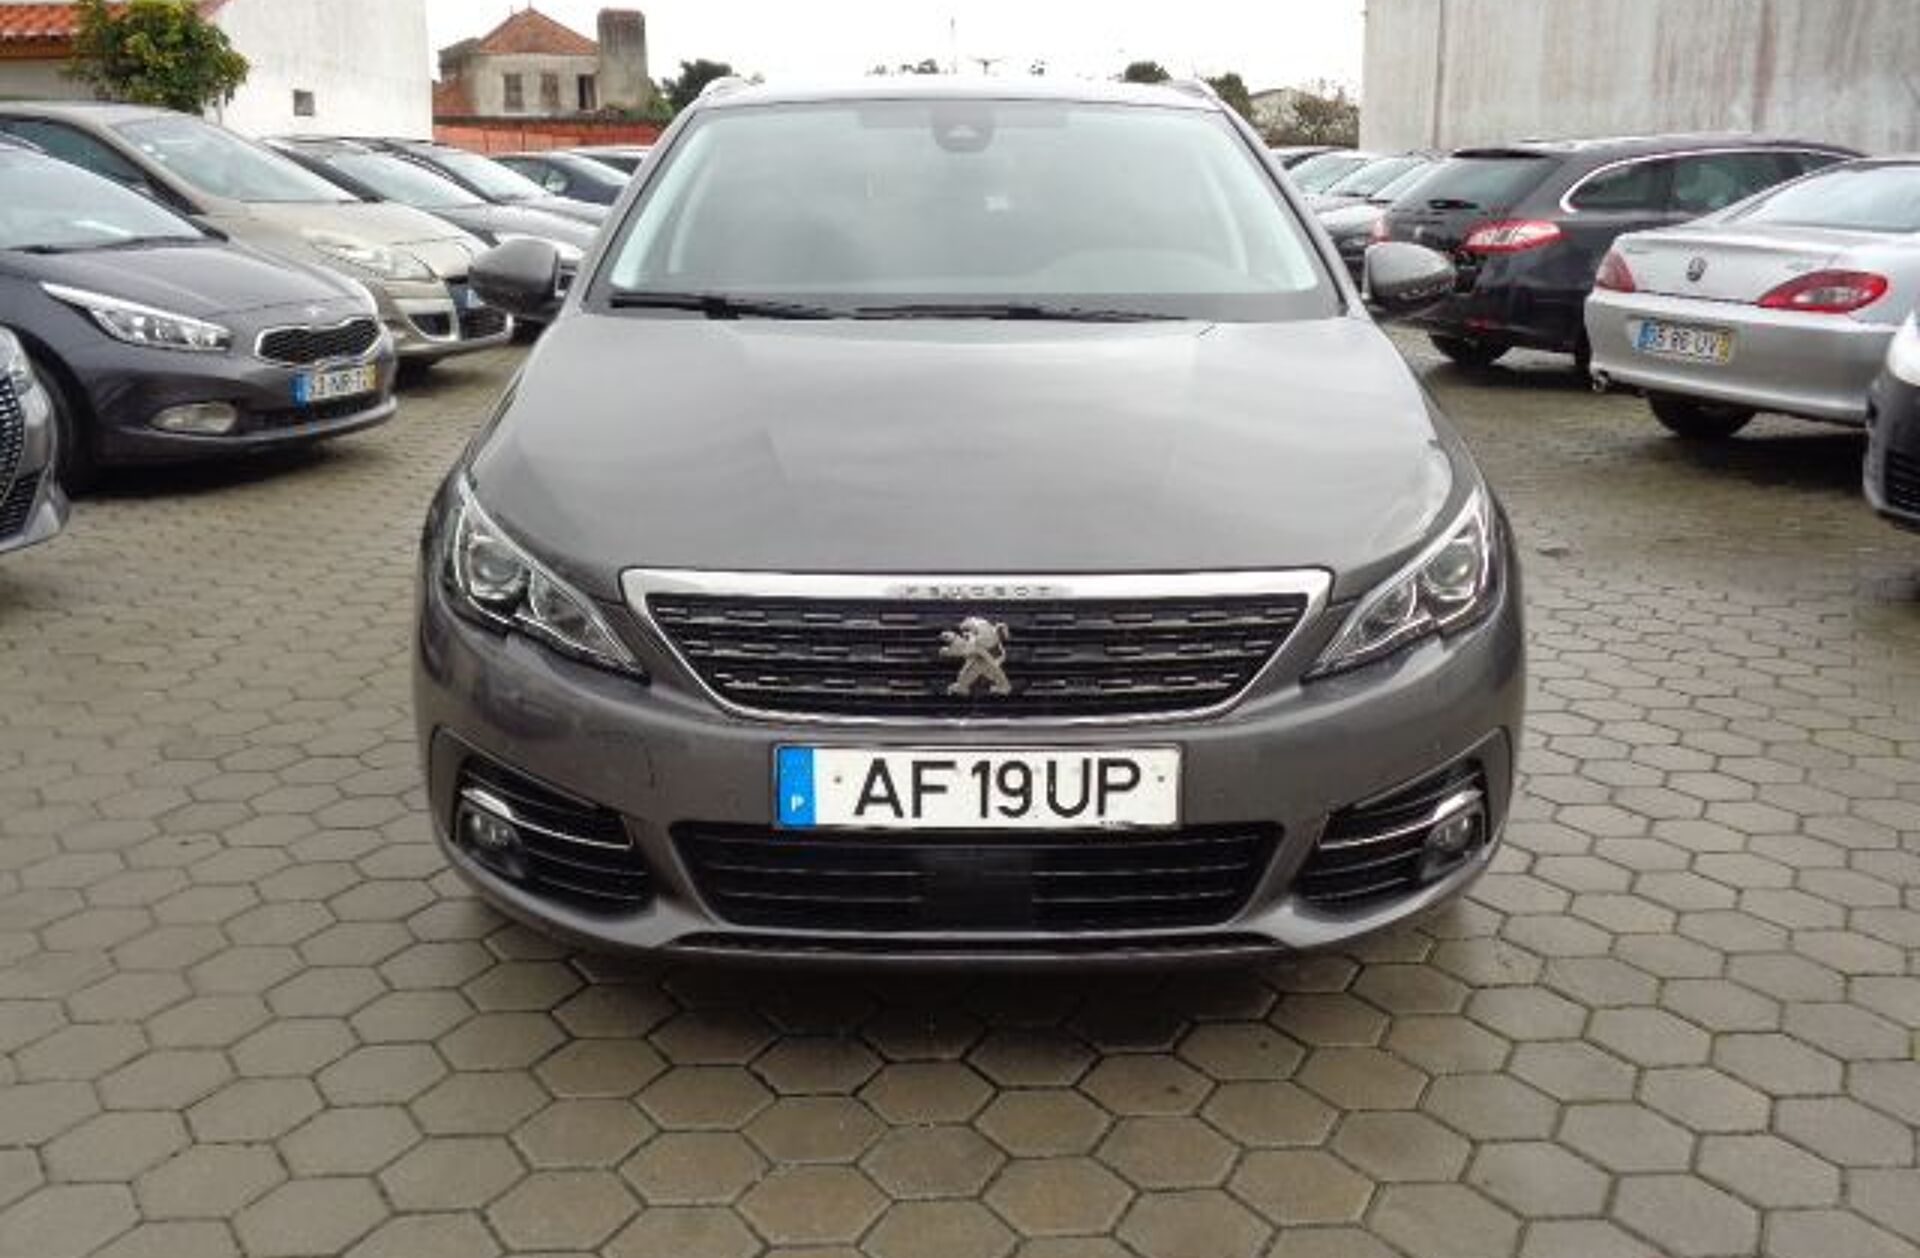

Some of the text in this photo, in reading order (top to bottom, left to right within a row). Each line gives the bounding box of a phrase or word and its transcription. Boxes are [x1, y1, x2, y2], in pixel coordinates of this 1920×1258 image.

[791, 795, 805, 812] P
[853, 757, 1142, 819] AF 19 UP
